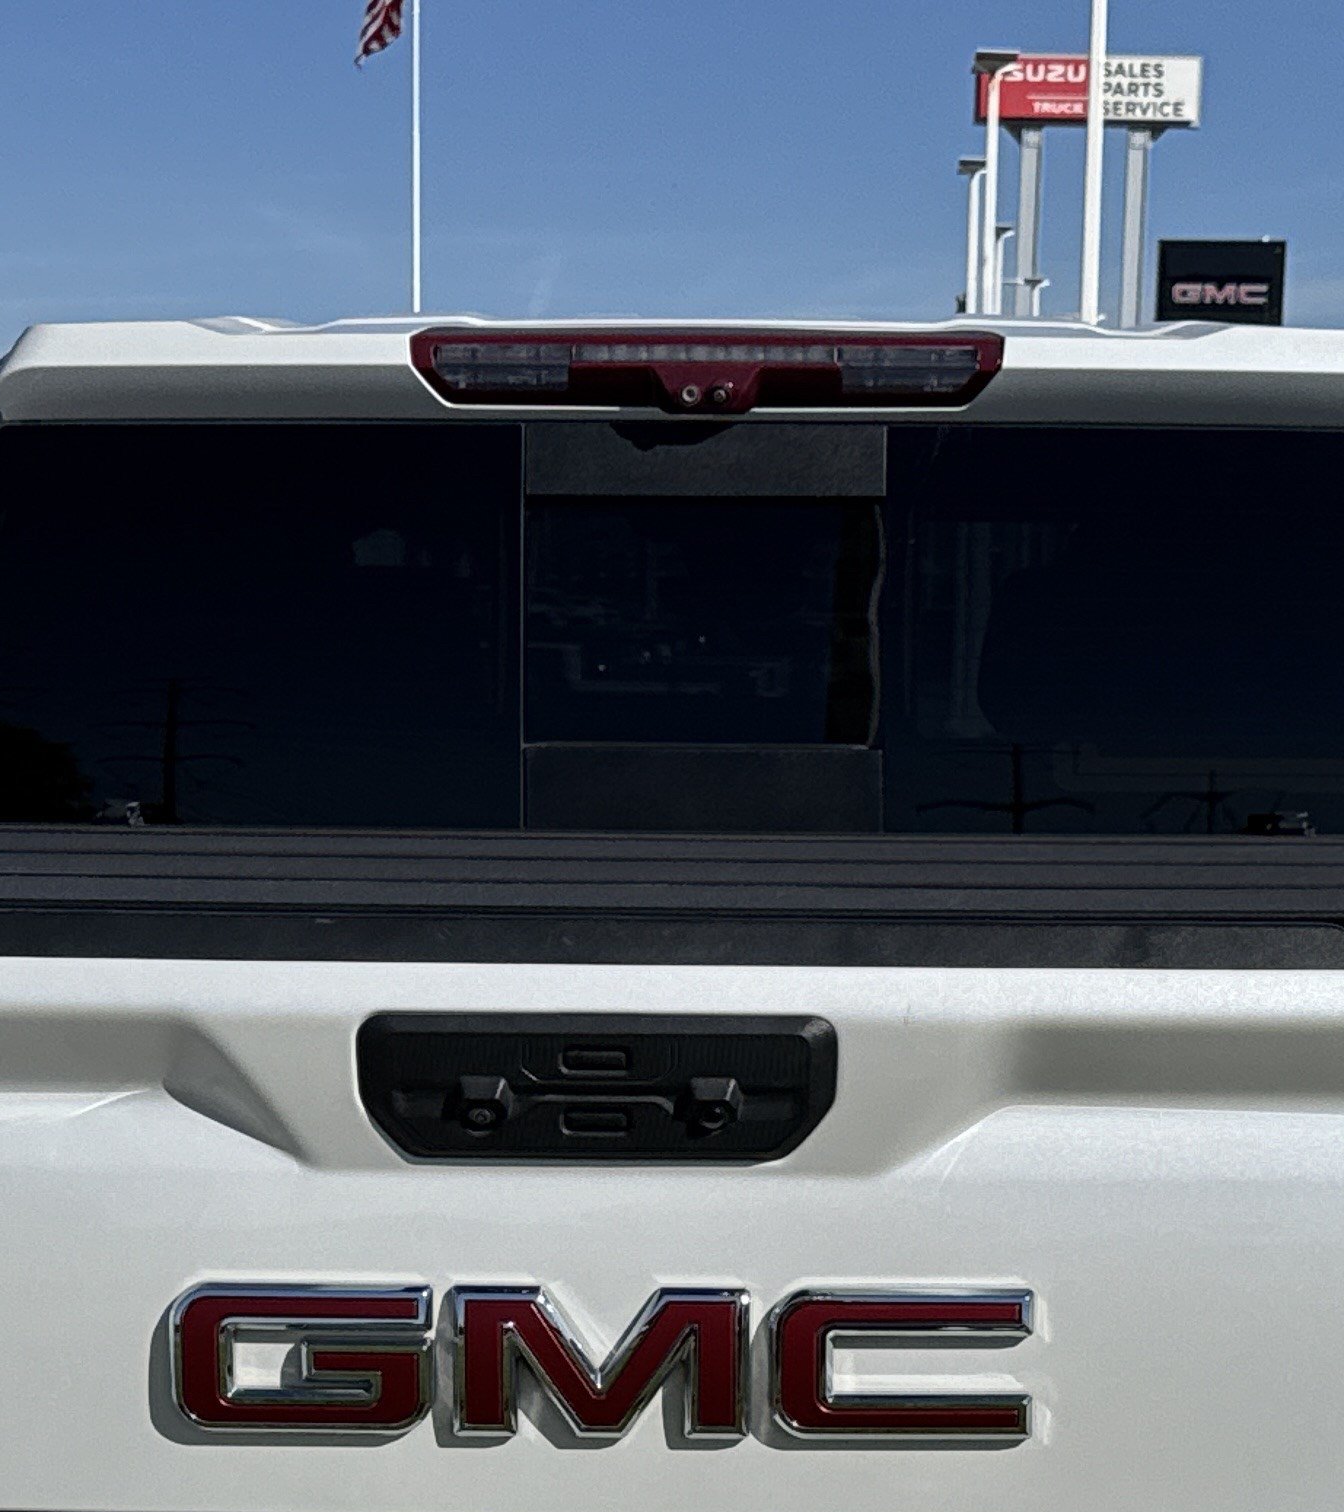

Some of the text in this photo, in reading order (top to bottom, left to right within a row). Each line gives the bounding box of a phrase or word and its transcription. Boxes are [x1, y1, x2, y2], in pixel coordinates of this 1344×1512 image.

[1104, 62, 1164, 78] SALES
[1103, 82, 1164, 98] PARTS
[1032, 102, 1084, 115] TRUCK
[1171, 283, 1269, 305] GMC
[166, 1283, 1034, 1440] GMC
